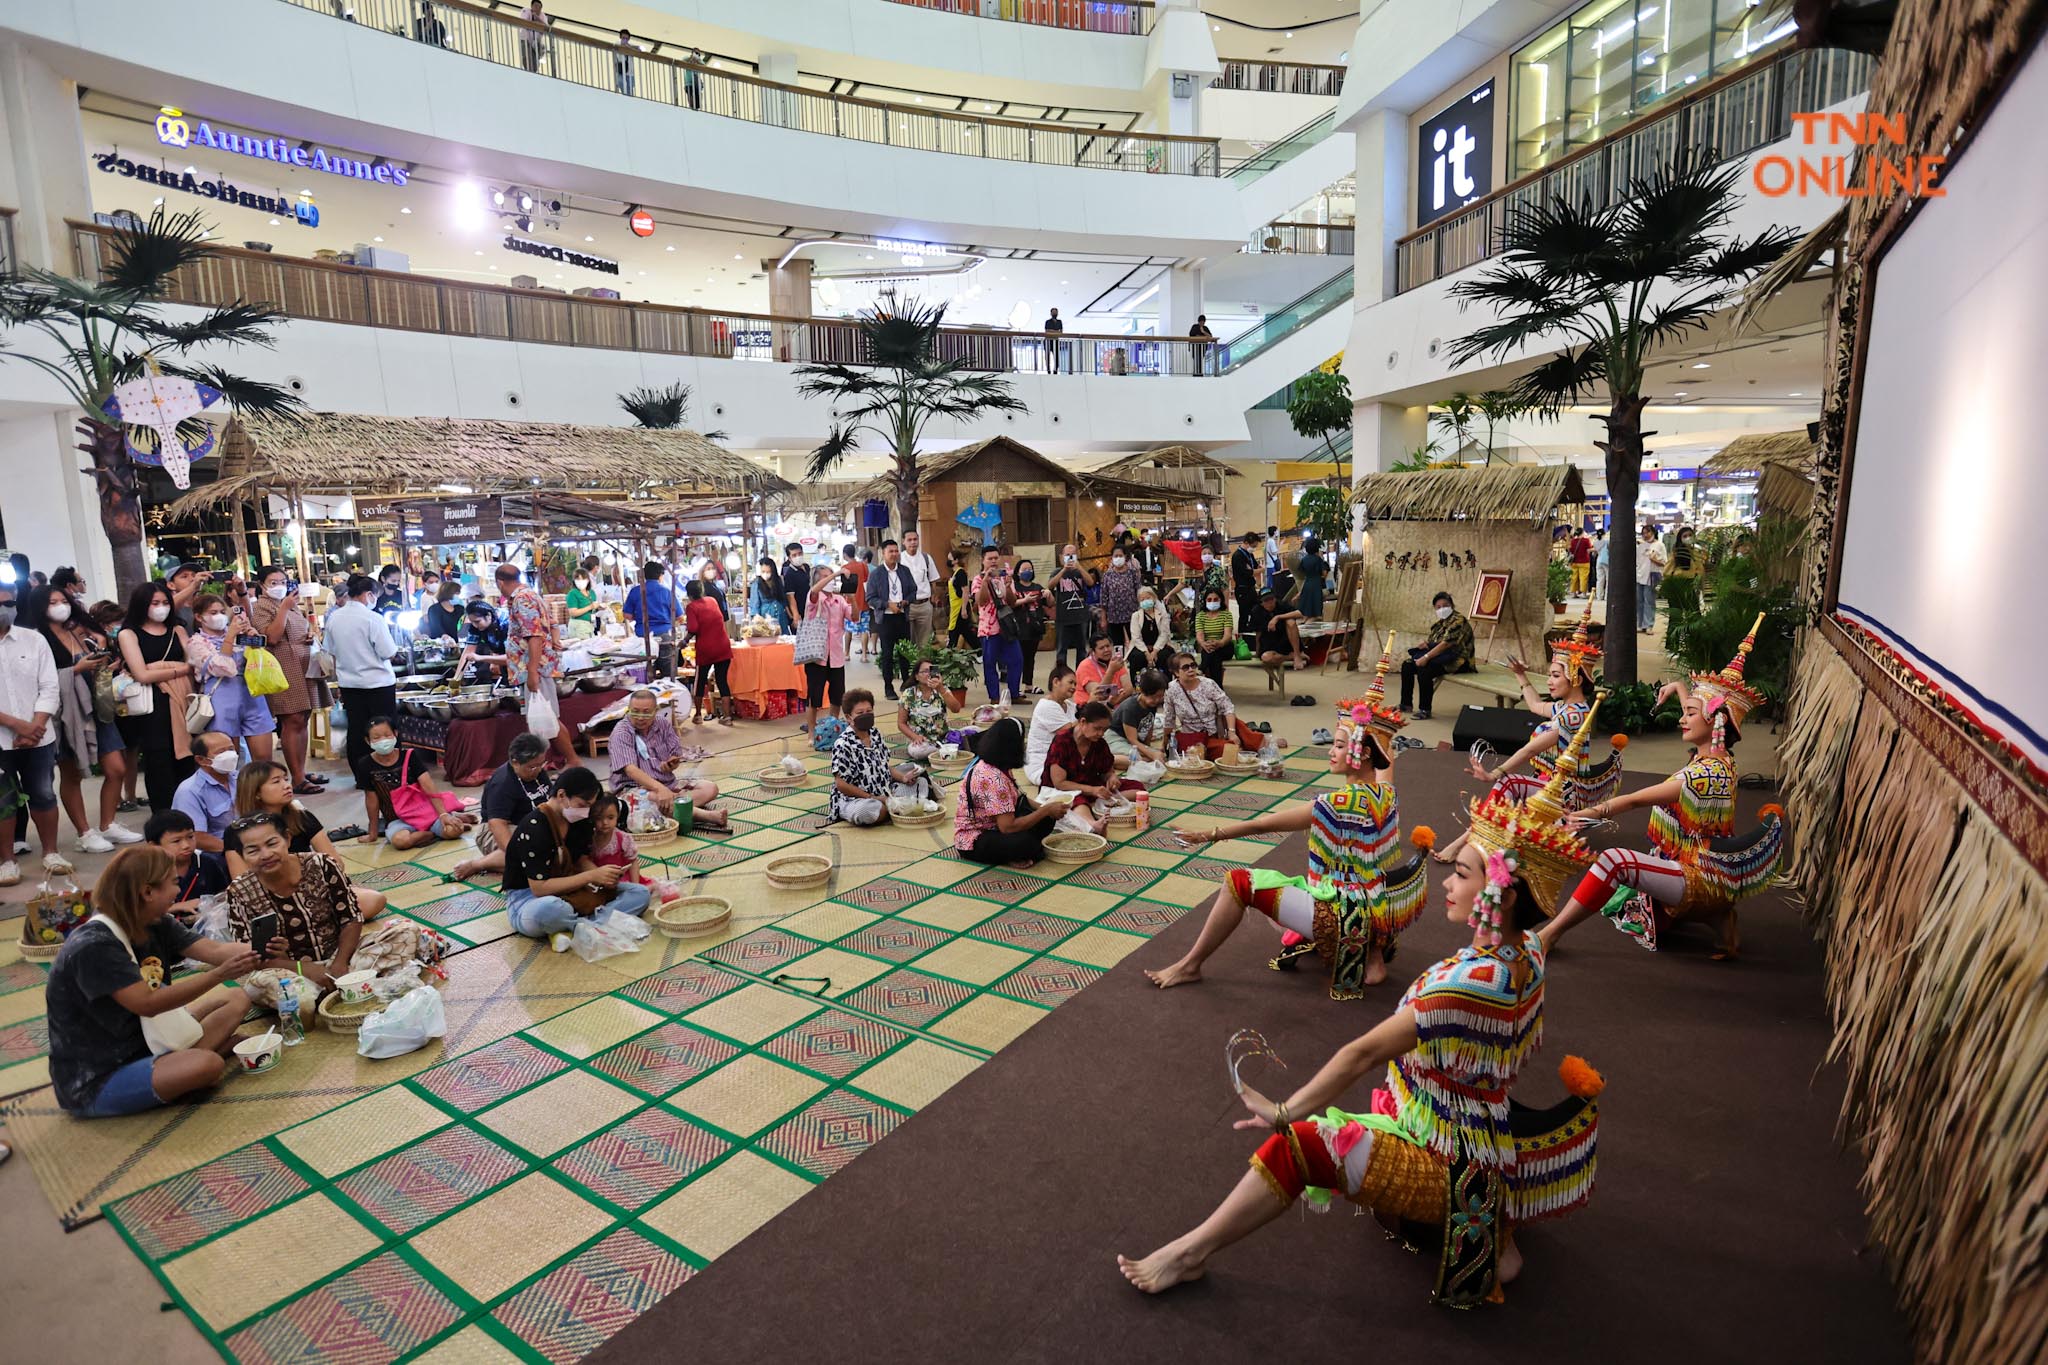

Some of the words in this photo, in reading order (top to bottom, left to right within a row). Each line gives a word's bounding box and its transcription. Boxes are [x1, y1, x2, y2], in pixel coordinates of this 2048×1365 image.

[194, 122, 308, 167] Auntie
[309, 148, 408, 186] Anne's
[1433, 125, 1475, 211] it
[1658, 470, 1679, 481] UOB
